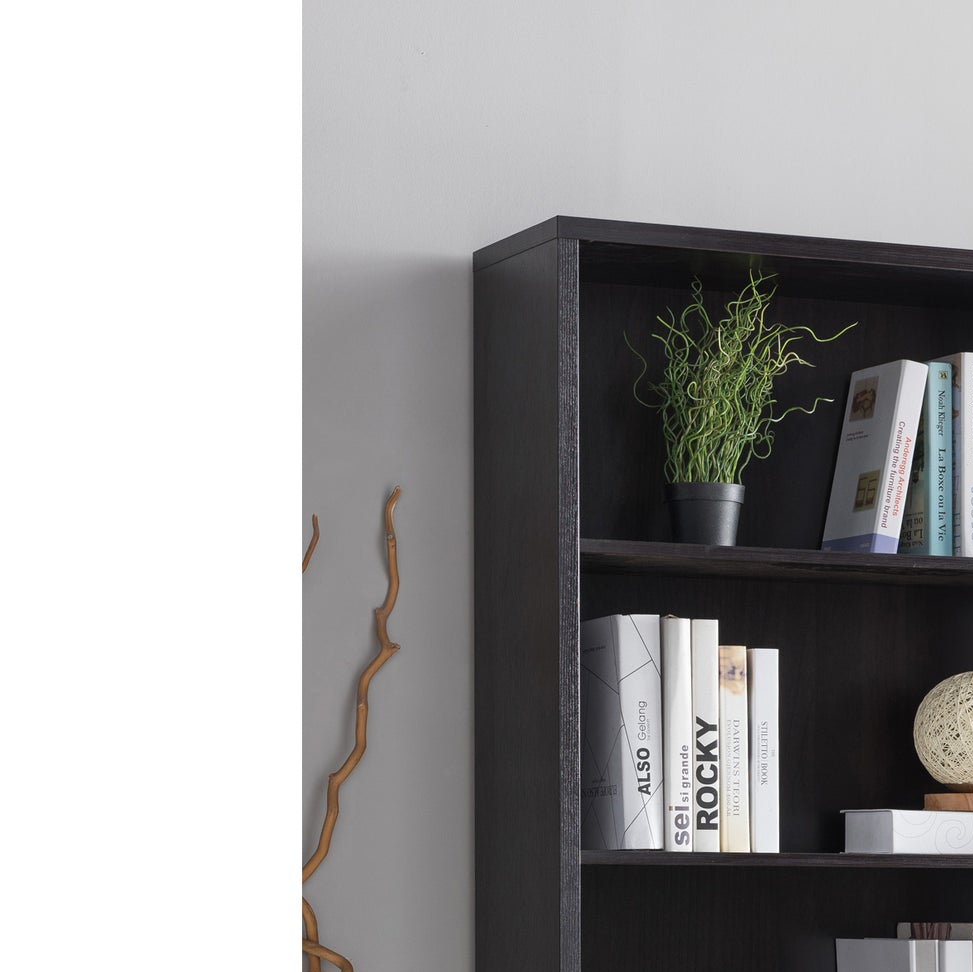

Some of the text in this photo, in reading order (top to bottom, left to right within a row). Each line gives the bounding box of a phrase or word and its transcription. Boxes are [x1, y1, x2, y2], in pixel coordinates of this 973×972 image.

[937, 390, 946, 437] Noah Klieger
[881, 421, 906, 529] Creating the furniture brand
[892, 437, 912, 517] Anderegg Architects
[938, 448, 947, 542] La Boxe ou la Vie
[637, 700, 652, 796] ALSO Gelang
[668, 744, 691, 846] sei si grande
[695, 716, 719, 831] ROCKY
[732, 719, 740, 817] DARWINS TEORI
[760, 721, 769, 786] STILETTO BOOK
